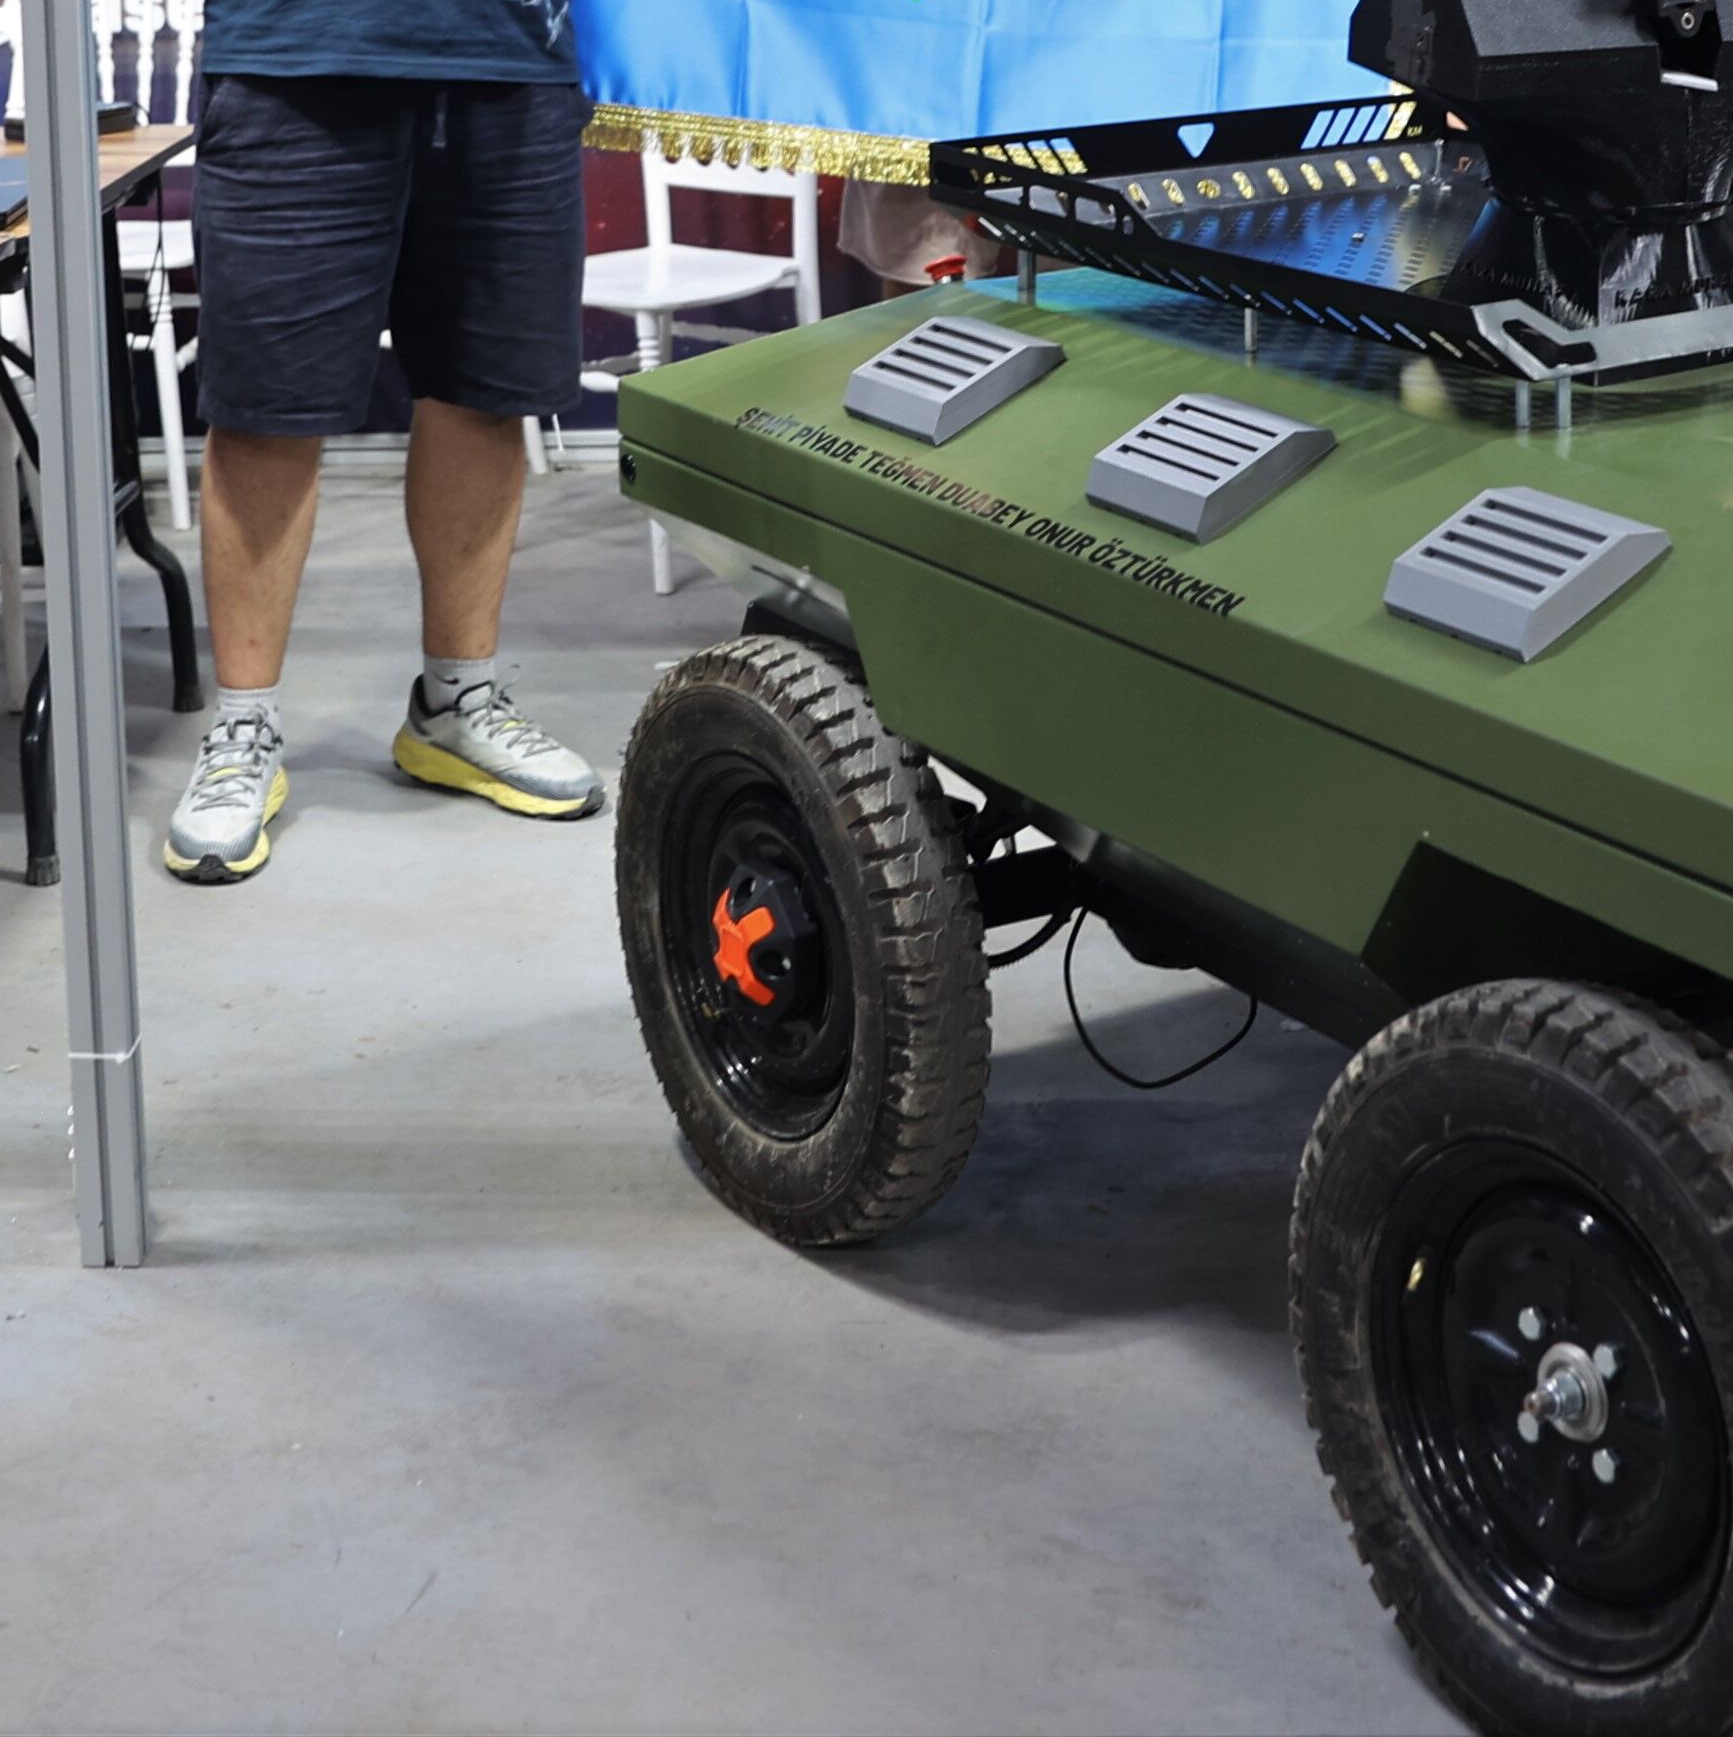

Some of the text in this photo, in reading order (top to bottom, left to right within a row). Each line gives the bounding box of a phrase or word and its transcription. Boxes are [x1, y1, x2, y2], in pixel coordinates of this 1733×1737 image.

[790, 425, 868, 465] PİYADE
[858, 449, 949, 497] TEĞMEN
[1024, 517, 1097, 557] ONUR
[1088, 537, 1246, 617] ÖZTÜRKMEN
